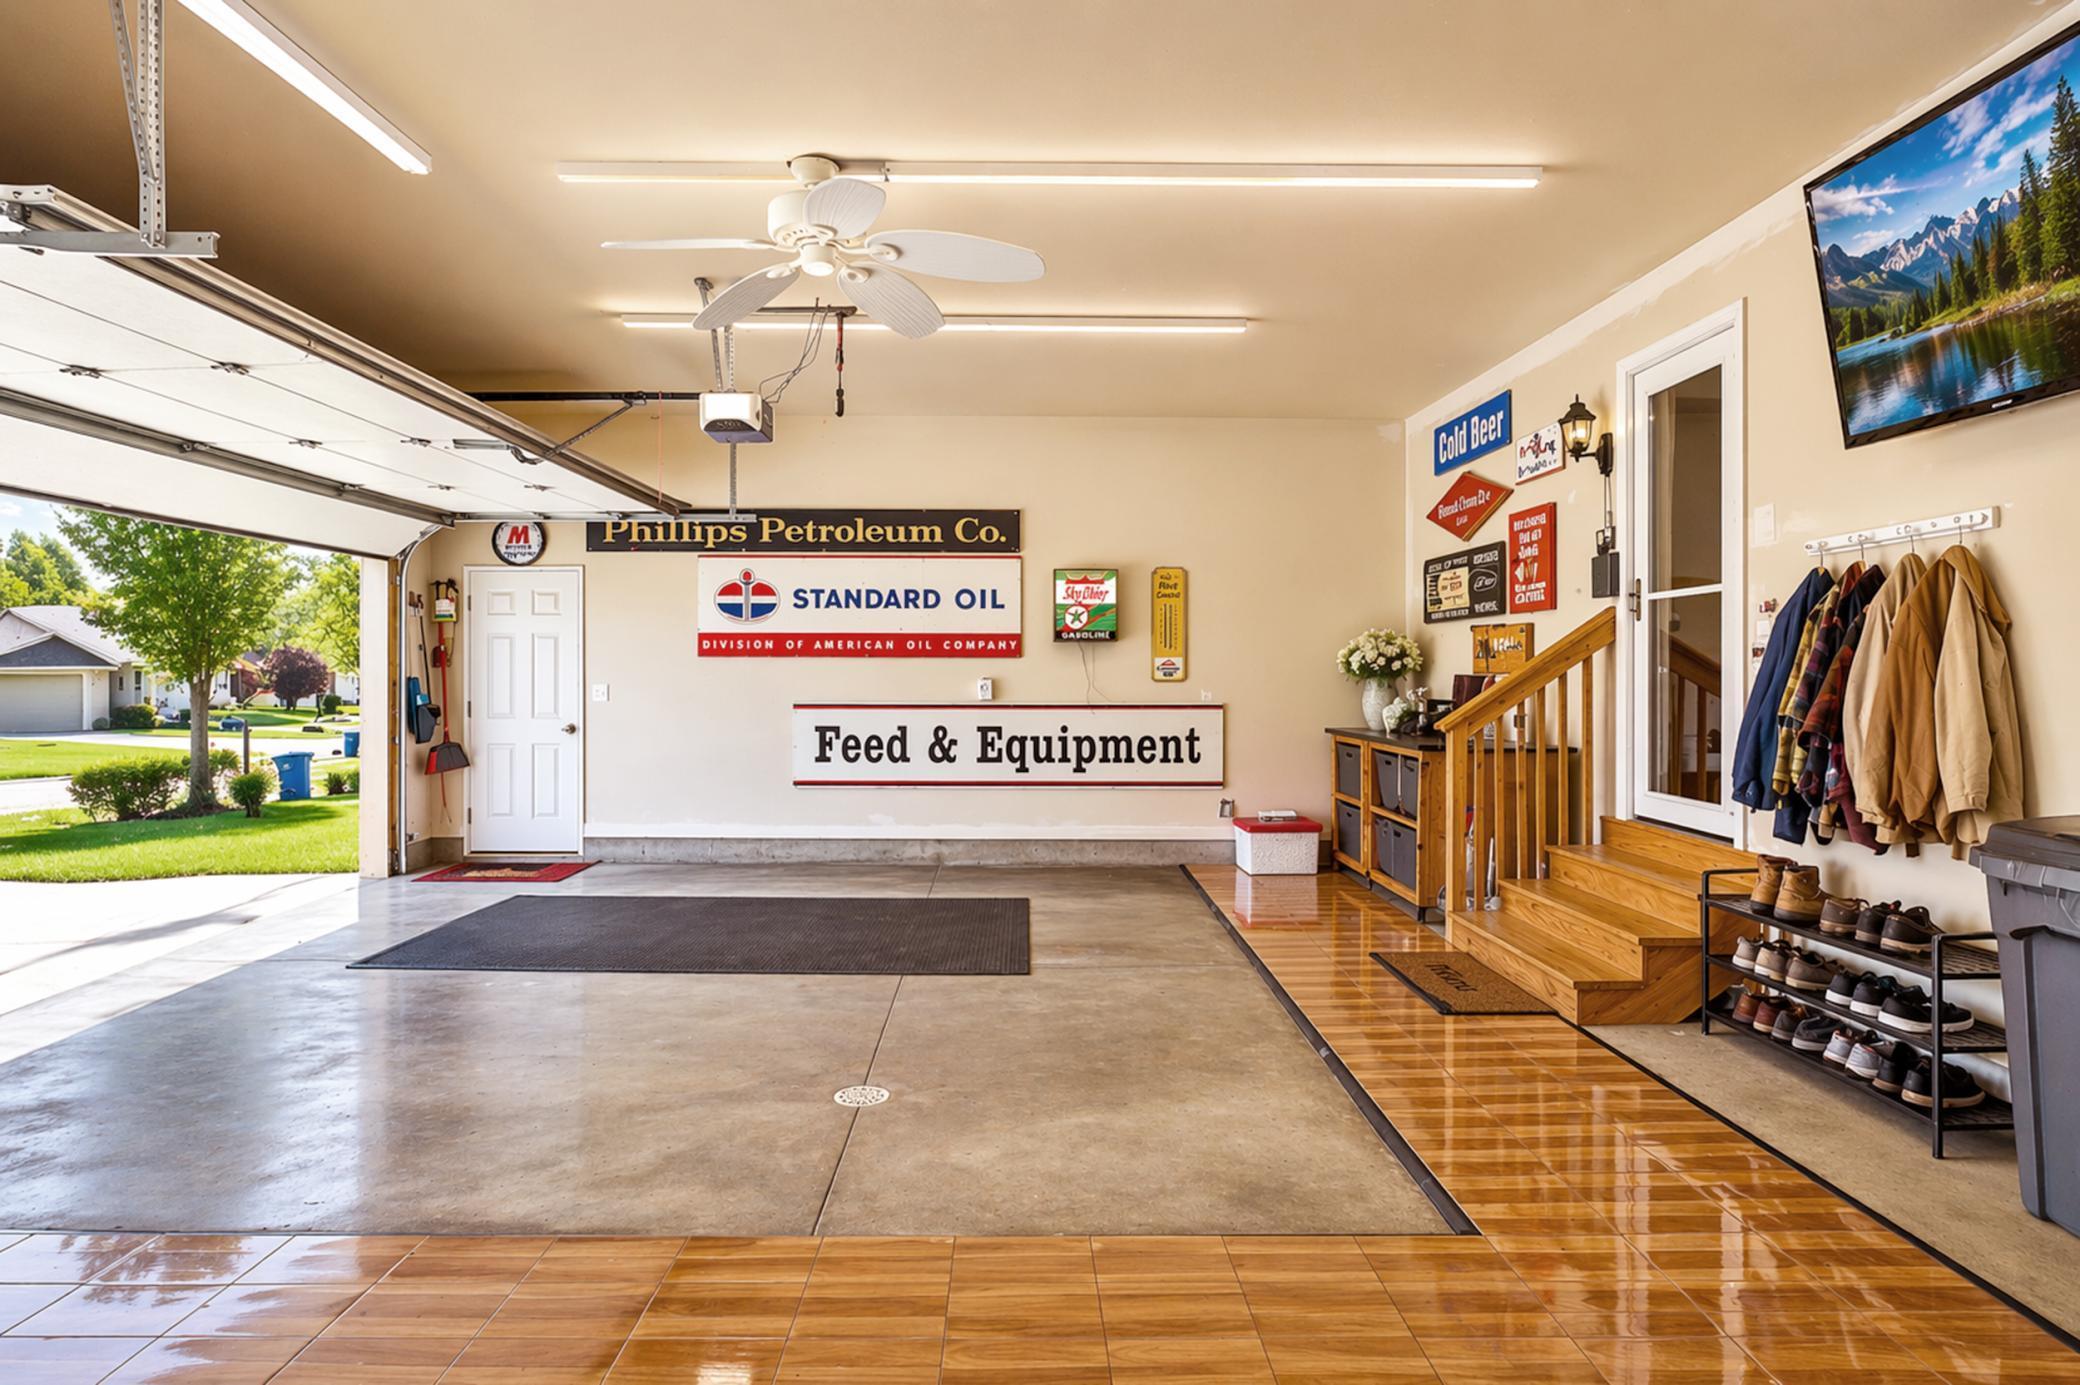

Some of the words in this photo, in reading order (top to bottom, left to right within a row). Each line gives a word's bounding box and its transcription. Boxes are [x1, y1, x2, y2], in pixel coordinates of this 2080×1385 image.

[1439, 419, 1468, 464] Cold
[1471, 410, 1504, 450] Beer
[507, 525, 530, 544] M
[603, 520, 748, 549] Phillips
[759, 517, 944, 543] Petroleum
[954, 516, 1007, 543] Co.
[793, 588, 941, 609] STANDARD
[955, 588, 1005, 610] OIL
[702, 639, 774, 650] DIVISION
[785, 639, 804, 650] OF
[814, 639, 895, 650] AMERICAN
[906, 640, 933, 650] OIL
[943, 640, 1018, 650] COMPANY
[1061, 631, 1111, 640] GASOLINE
[814, 725, 911, 764] Feed
[927, 724, 958, 764] &
[976, 724, 1202, 774] Equipment
